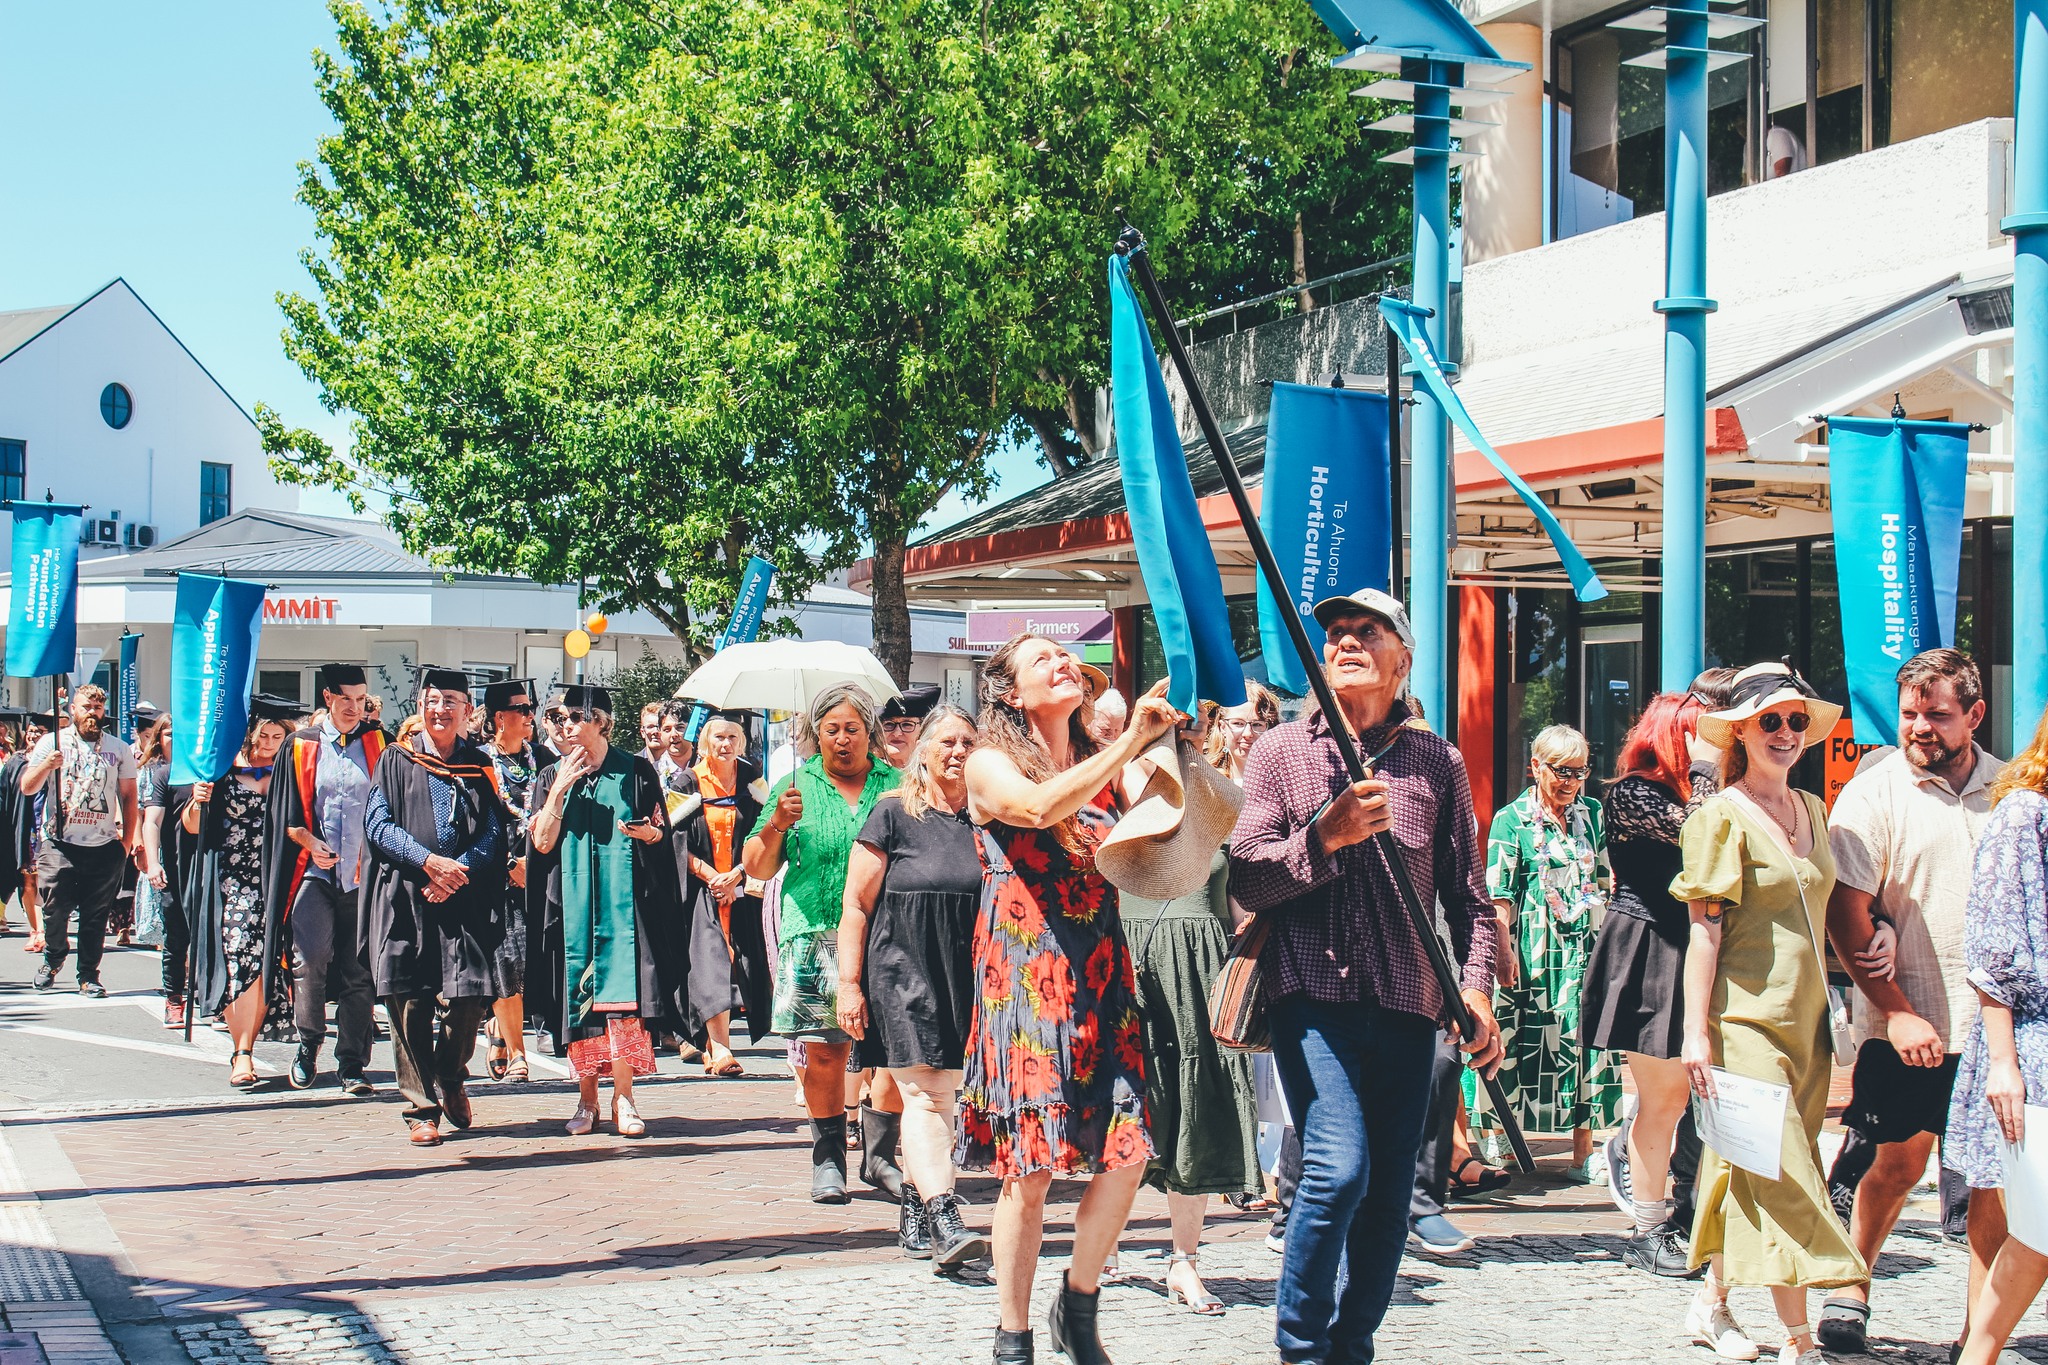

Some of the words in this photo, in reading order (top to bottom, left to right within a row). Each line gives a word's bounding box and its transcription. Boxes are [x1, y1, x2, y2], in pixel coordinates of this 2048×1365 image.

[1300, 466, 1329, 616] Horticulture
[1333, 501, 1348, 519] Te
[54, 548, 61, 561] He
[1327, 523, 1345, 587] Ahuone
[1878, 513, 1905, 660] Hospitality
[1907, 525, 1921, 648] Manaakitanga
[25, 554, 40, 622] Pathways
[36, 549, 52, 628] Foundation
[731, 572, 761, 633] Aviation
[203, 608, 219, 674] Applied
[220, 644, 229, 657] Te
[1026, 619, 1080, 634] Farmers
[218, 659, 228, 685] Kura
[195, 678, 214, 755] Business
[213, 688, 226, 723] Pakihi
